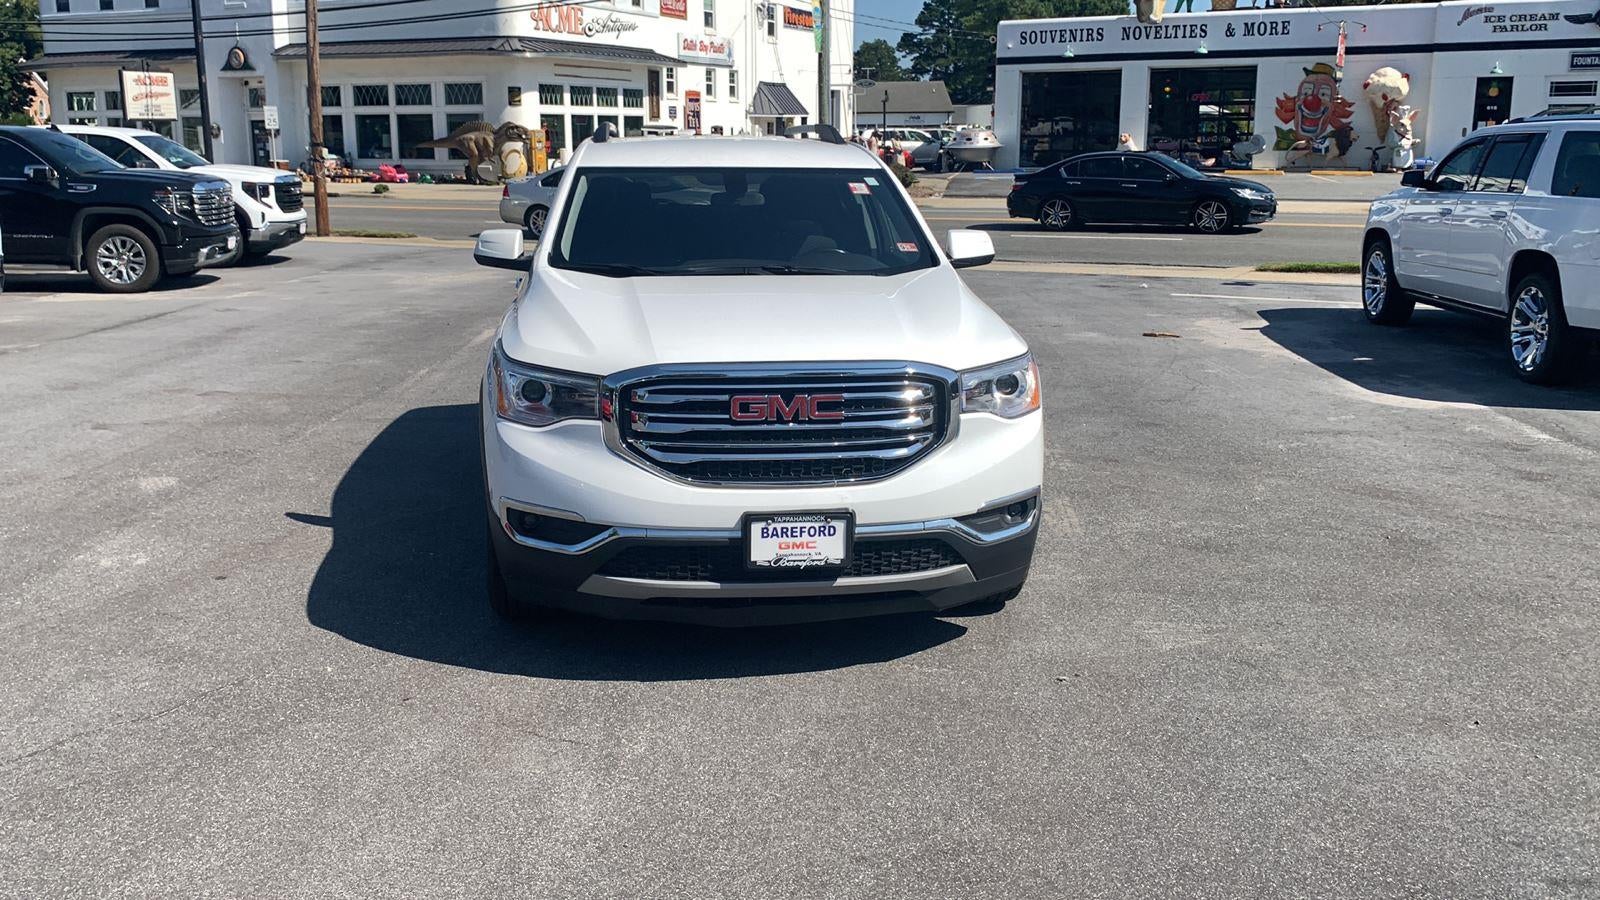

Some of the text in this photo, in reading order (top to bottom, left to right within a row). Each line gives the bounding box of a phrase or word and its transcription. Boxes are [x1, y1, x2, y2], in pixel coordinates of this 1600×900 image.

[530, 2, 584, 35] ACME
[1483, 12, 1560, 24] ICE CREAM
[1020, 20, 1291, 45] SOUVENIRS NOVELTIES & MORE
[1492, 23, 1548, 33] PARLOR
[267, 118, 277, 127] 25
[731, 394, 845, 421] GMC
[761, 525, 836, 539] BAREFORD
[778, 541, 817, 550] GMC
[771, 556, 828, 569] Bareford
